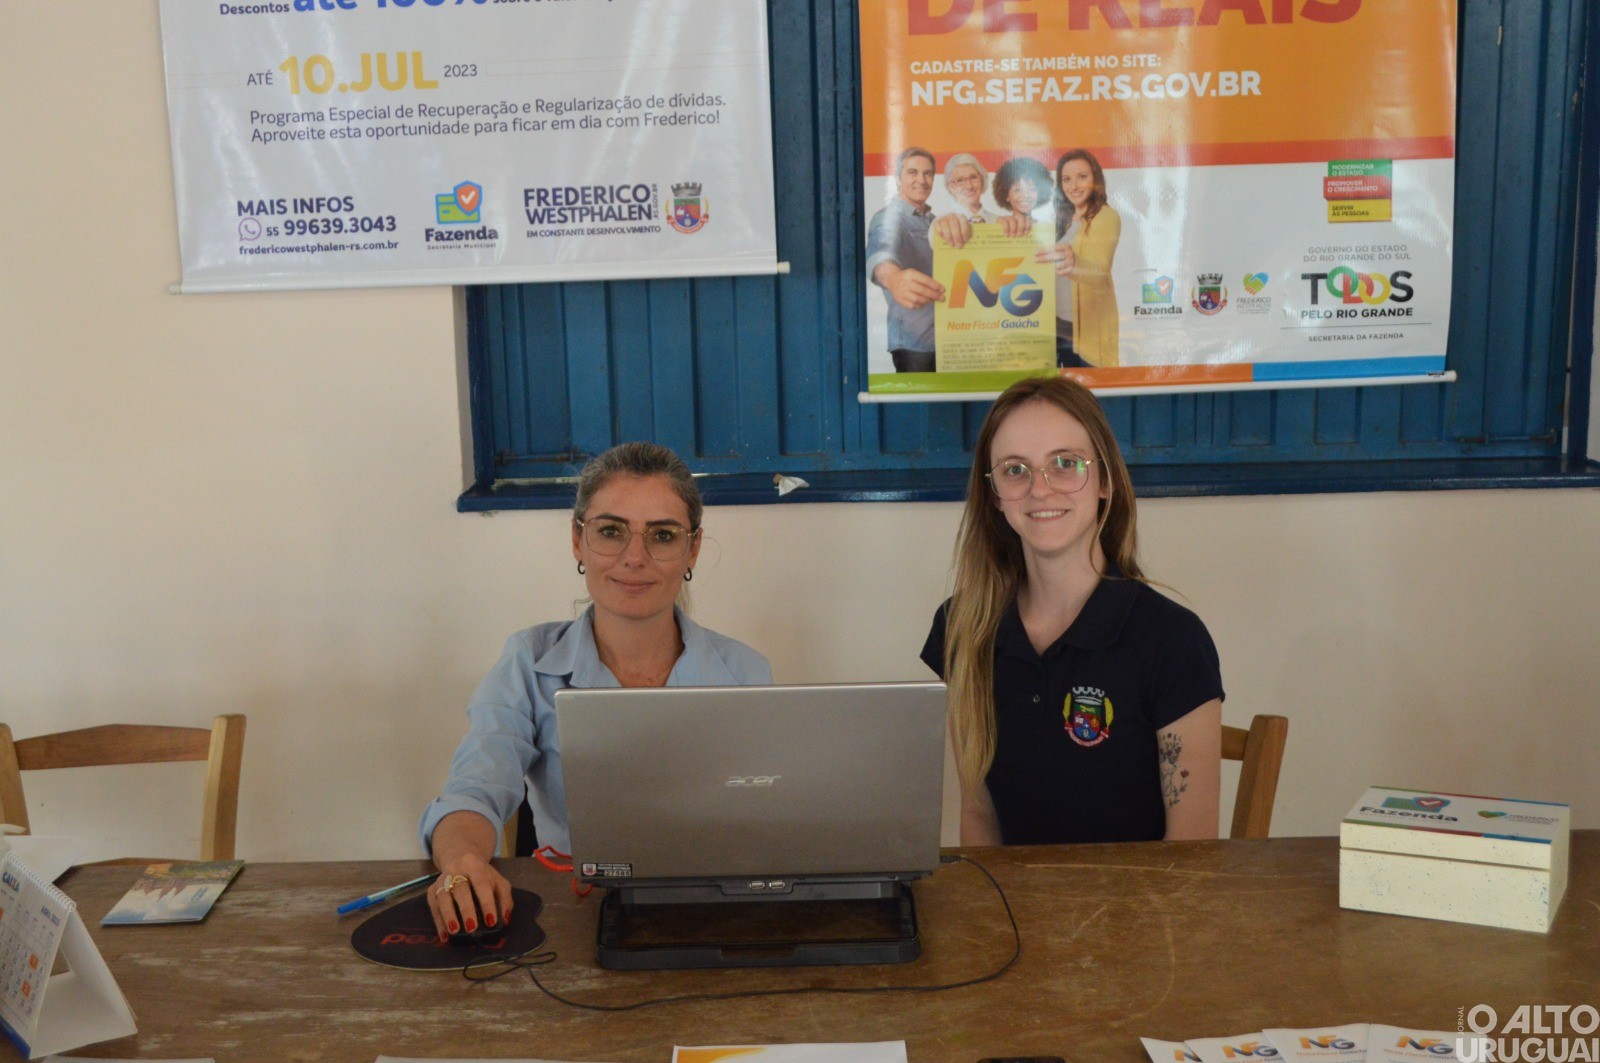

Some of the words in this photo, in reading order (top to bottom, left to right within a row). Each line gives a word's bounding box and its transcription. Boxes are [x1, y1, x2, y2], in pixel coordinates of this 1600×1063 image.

[219, 2, 290, 15] Descontos
[910, 58, 1020, 74] CADASTRE-SE
[1022, 53, 1090, 71] TAMBÉM
[1094, 55, 1119, 69] NO
[1125, 53, 1162, 67] SITE:
[246, 69, 274, 86] ATÉ
[278, 51, 439, 95] 10.JUL
[443, 64, 478, 78] 2023
[911, 70, 1262, 106] NFG.SEFAZ.RS.GOV.BR
[250, 109, 325, 127] Programa
[329, 105, 390, 124] Especial
[395, 104, 414, 118] de
[418, 100, 518, 119] Recuperação
[522, 102, 531, 113] e
[535, 96, 642, 116] Regularização
[646, 94, 665, 109] de
[668, 92, 726, 108] dívidas.
[251, 126, 326, 145] Aproveite
[329, 125, 362, 139] esta
[365, 121, 470, 141] oportunidade
[473, 121, 508, 137] para
[511, 117, 548, 132] ficar
[551, 118, 576, 130] em
[579, 115, 602, 129] dia
[606, 116, 640, 128] com
[644, 109, 720, 127] Frederico!
[523, 183, 651, 208] FREDERICO
[236, 198, 288, 217] MAIS
[293, 195, 355, 214] INFOS
[525, 203, 653, 225] WESTPHALEN
[266, 226, 280, 237] 55
[283, 215, 397, 236] 99639.3043
[424, 225, 499, 242] Fazenda
[526, 230, 539, 238] EM
[539, 228, 585, 238] CONSTANTE
[586, 225, 662, 236] DESENVOLVIMENTO
[239, 240, 399, 255] fredericowestphalen-rs.com.br
[1308, 245, 1353, 254] GOVERNO
[1355, 245, 1369, 253] DO
[1371, 244, 1407, 252] ESTADO
[1303, 255, 1317, 263] DO
[1319, 254, 1335, 262] RIO
[1338, 253, 1376, 261] GRANDE
[1395, 252, 1411, 260] SUL
[948, 257, 1043, 317] NFG
[1301, 266, 1414, 305] TODOS
[1133, 304, 1183, 315] Fazenda
[1301, 309, 1333, 319] PELO
[1336, 309, 1358, 319] RIO
[1361, 307, 1414, 318] GRANDE
[947, 321, 972, 331] Nota
[972, 320, 1000, 331] Fiscal
[1001, 317, 1039, 328] Gaúcha
[1308, 334, 1355, 342] SECRETARIA
[1368, 332, 1404, 340] FAZENDA
[725, 775, 783, 787] acer
[1360, 806, 1459, 822] Fazenda
[1298, 1034, 1355, 1050] NFG
[1395, 1035, 1454, 1055] NFG
